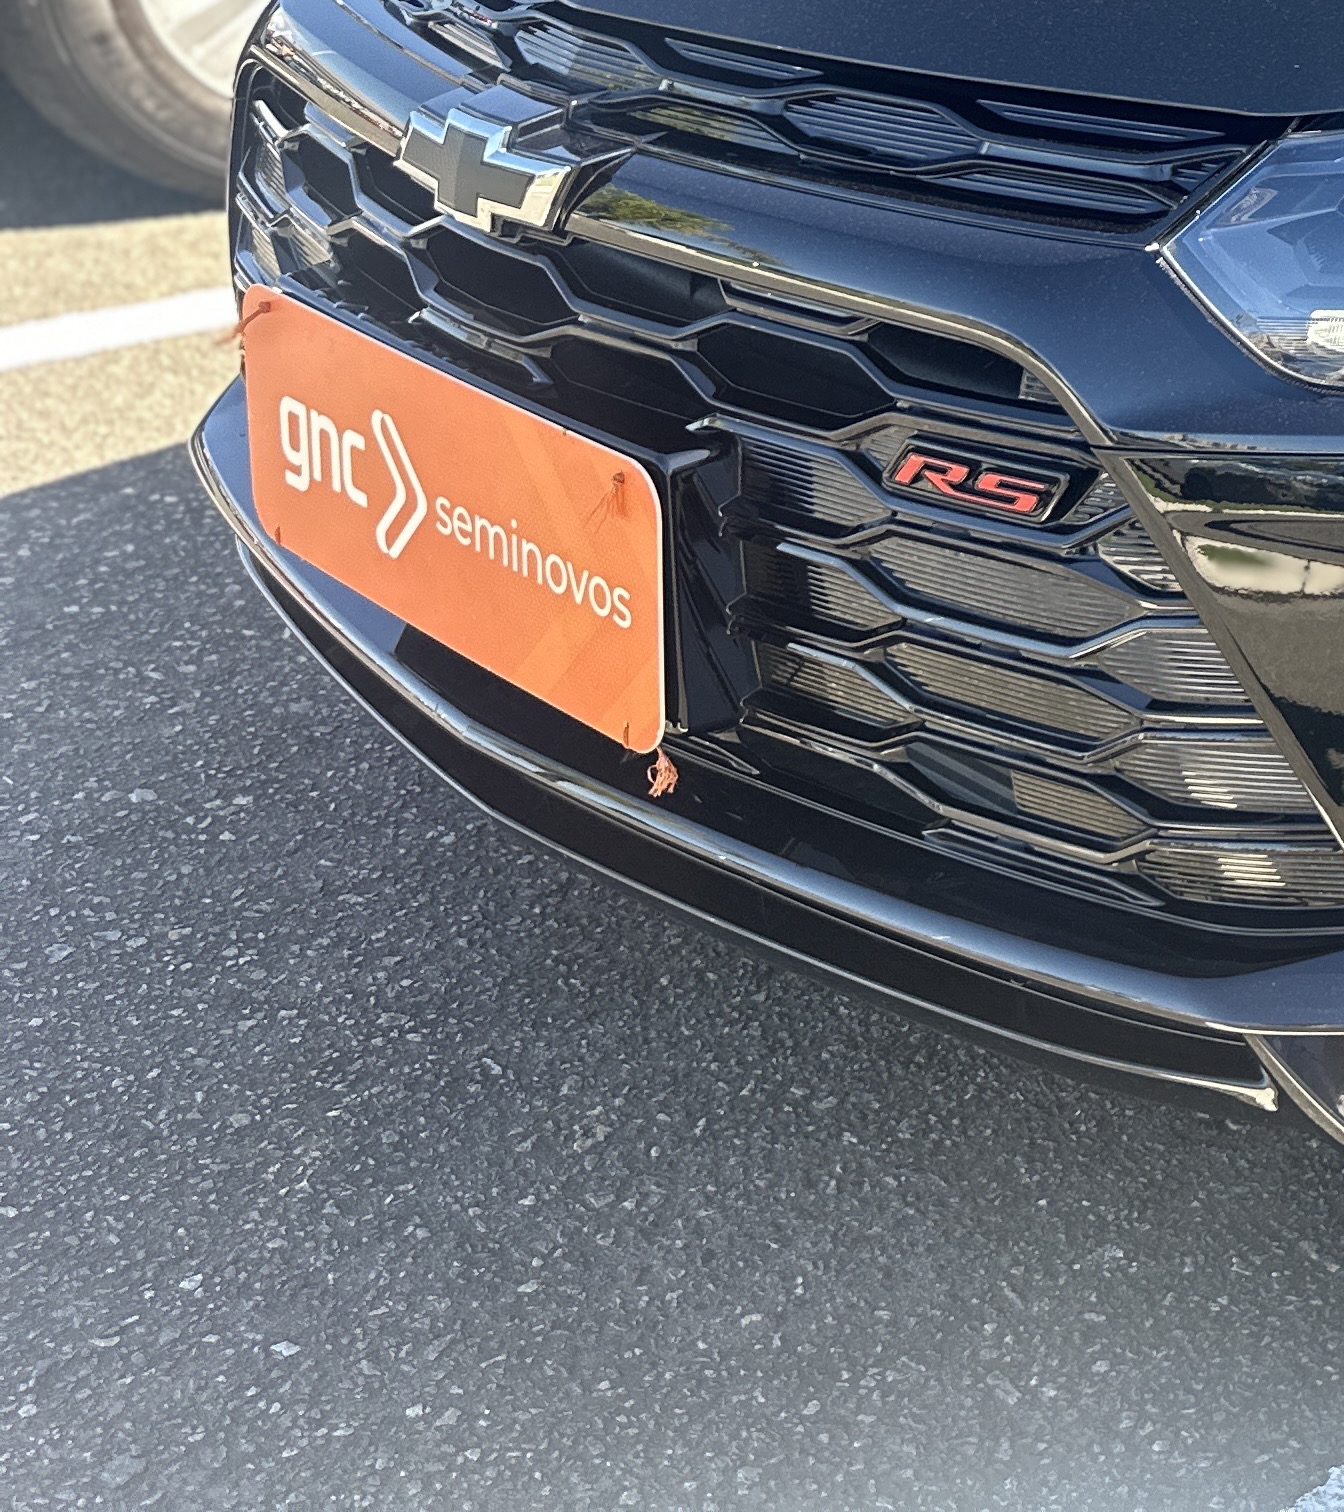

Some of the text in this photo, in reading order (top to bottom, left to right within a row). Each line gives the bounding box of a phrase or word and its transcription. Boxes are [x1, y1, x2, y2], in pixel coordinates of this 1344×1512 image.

[280, 394, 368, 505] gnc
[891, 453, 1049, 515] RS
[436, 496, 632, 629] seminovos
